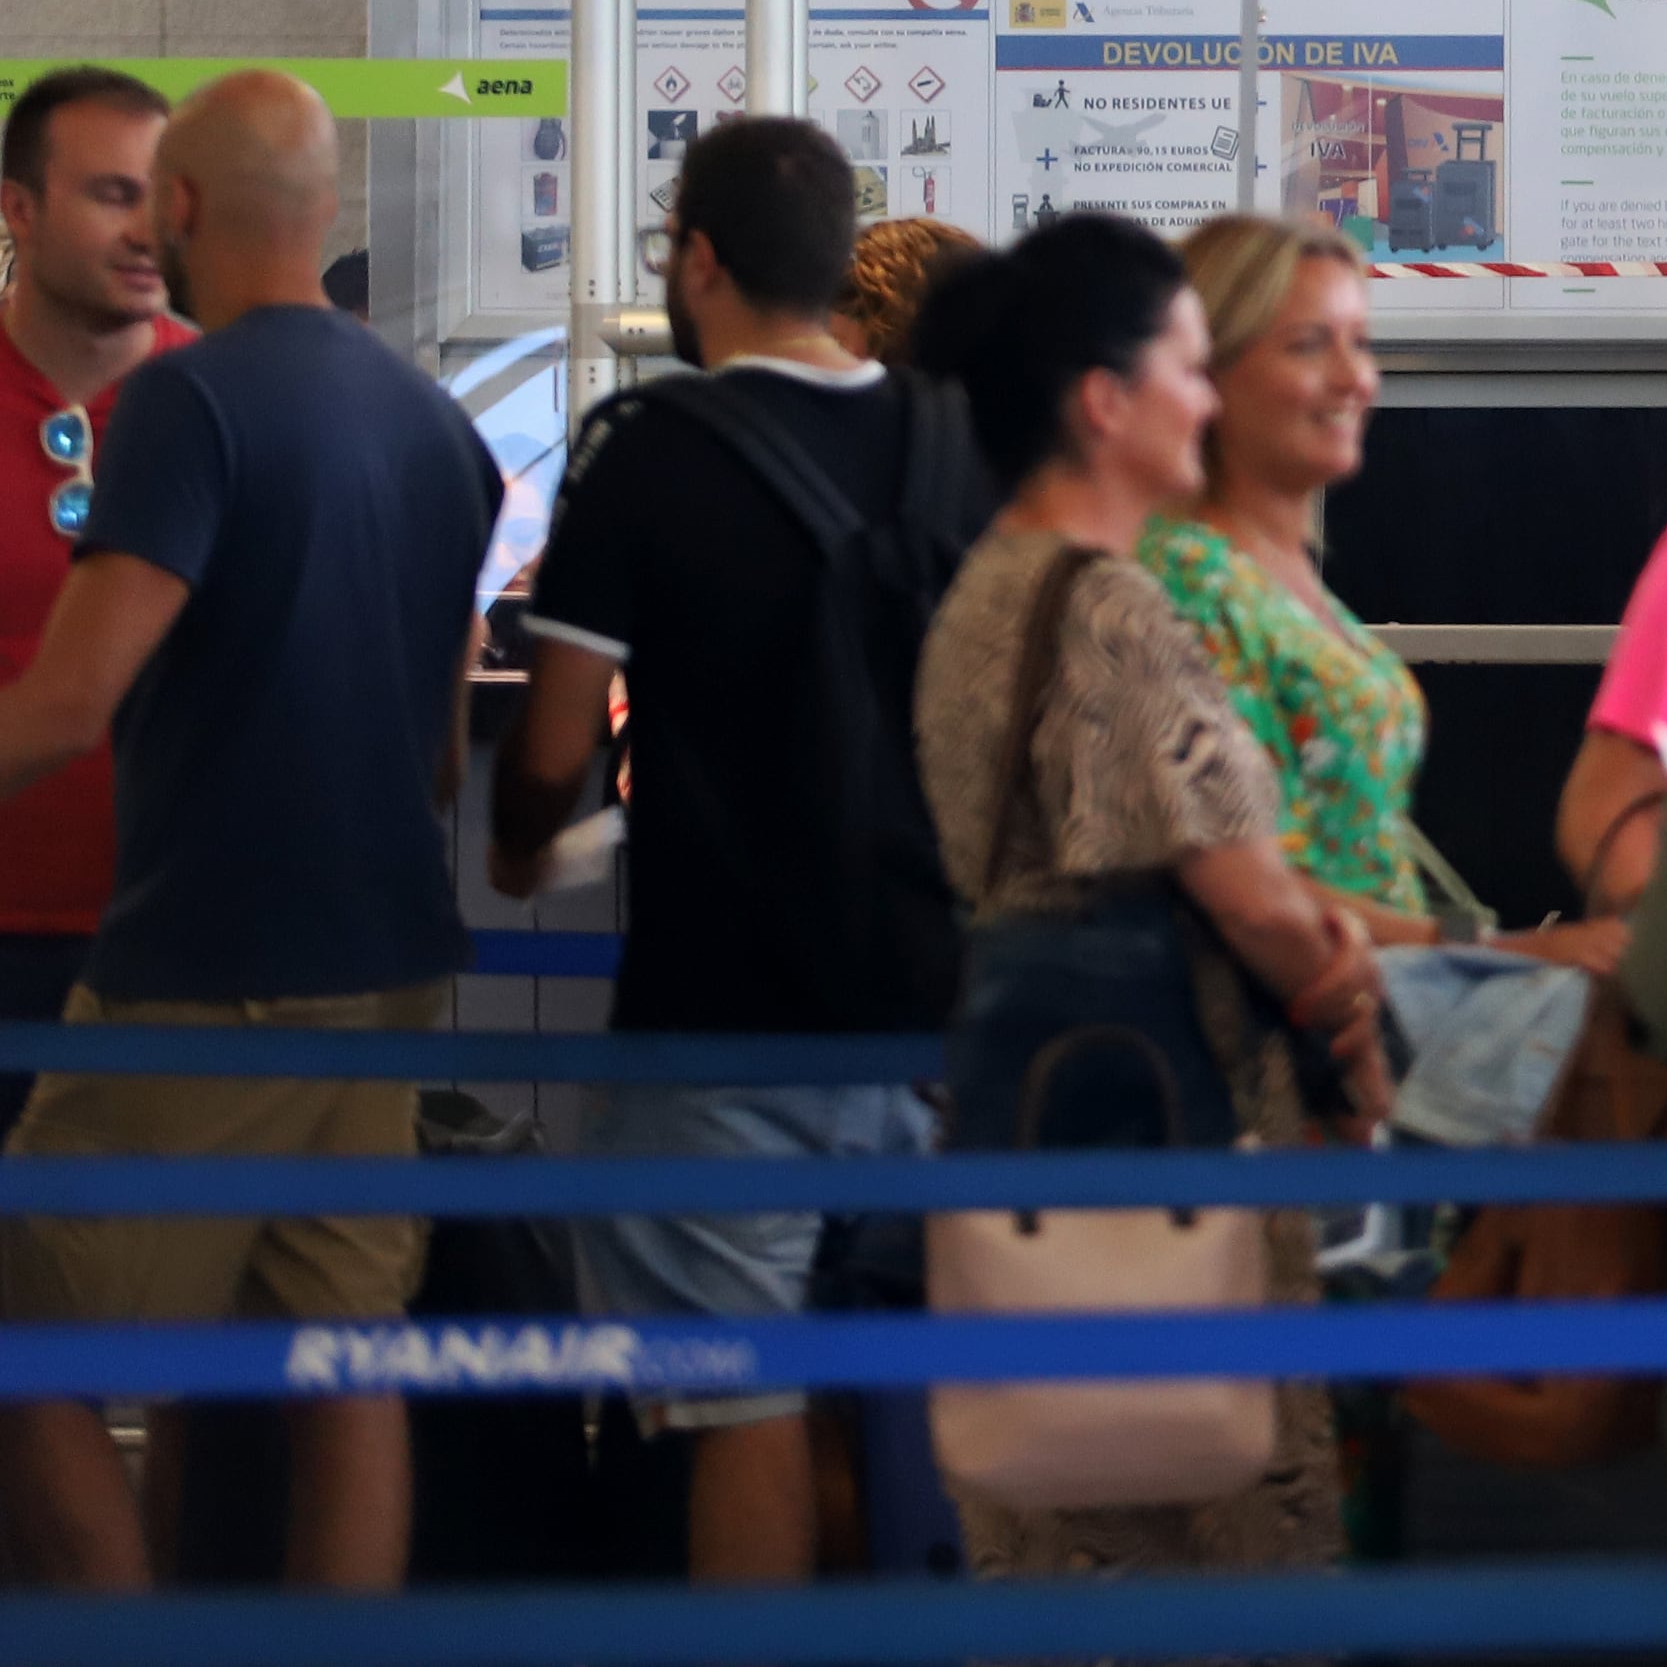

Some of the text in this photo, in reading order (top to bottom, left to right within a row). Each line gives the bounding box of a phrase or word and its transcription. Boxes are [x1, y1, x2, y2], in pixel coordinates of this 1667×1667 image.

[1104, 37, 1398, 65] DEVOLUCÓN DE IVA
[477, 80, 532, 95] aena
[1084, 98, 1230, 110] NO RESIDENTES UE
[1171, 146, 1208, 155] EUROS
[1311, 140, 1347, 160] IVA
[1074, 160, 1232, 172] NO EXPEDICIÓN COMERCIAL
[1132, 201, 1152, 209] SUS
[1155, 201, 1208, 209] COMPRAS
[1212, 201, 1227, 210] EN
